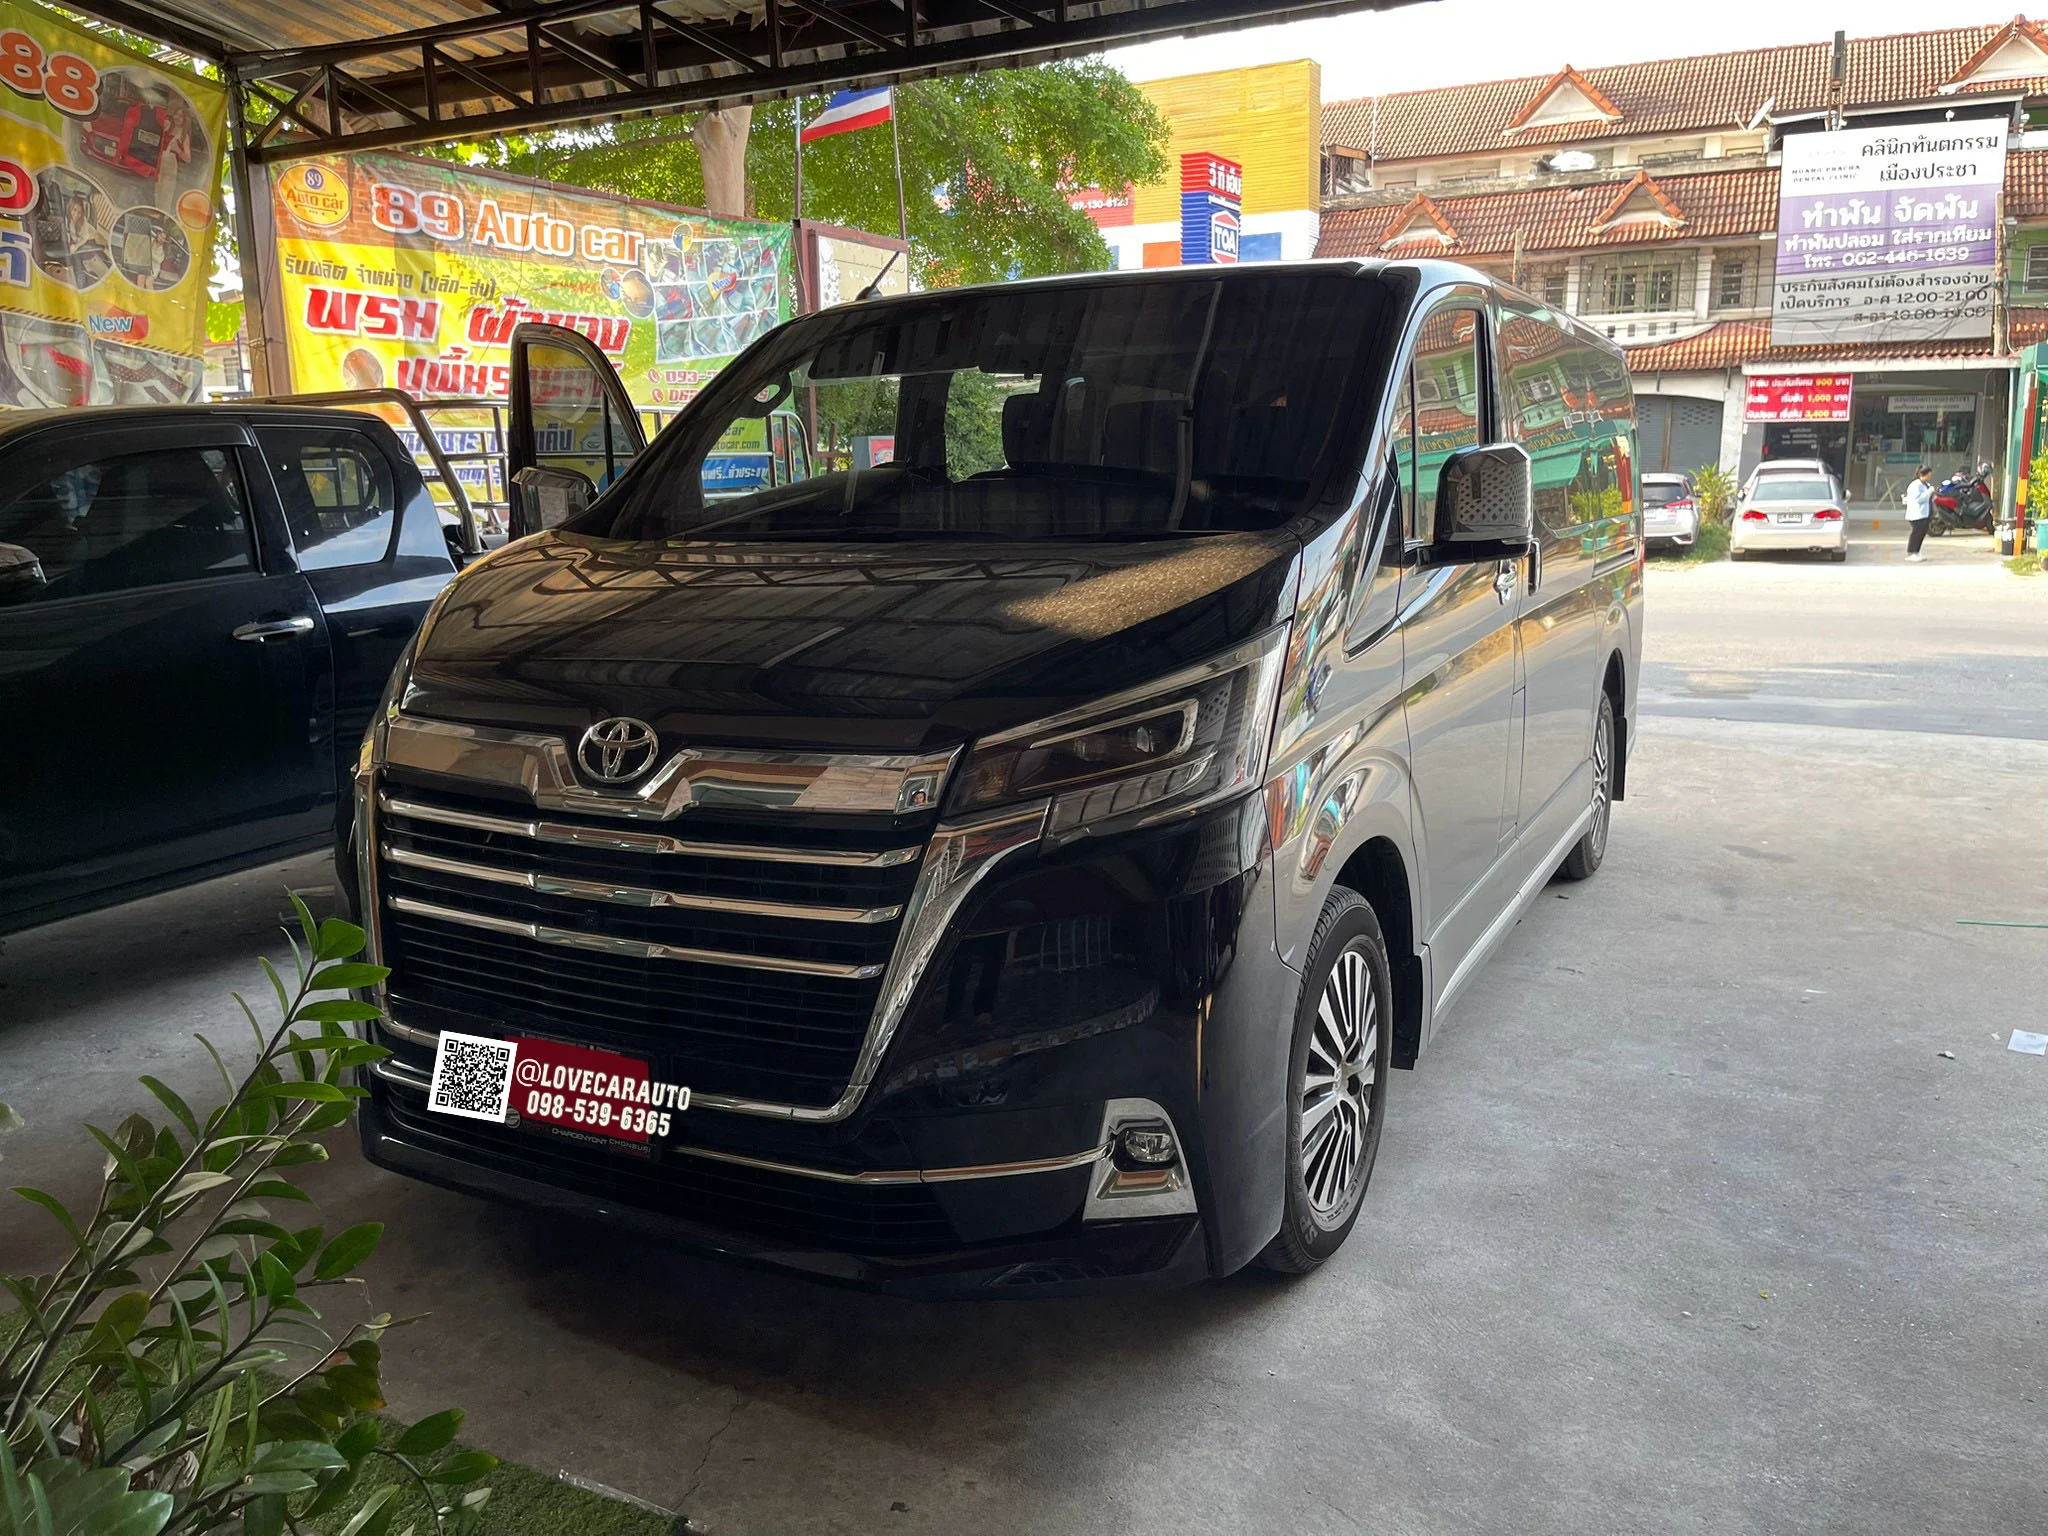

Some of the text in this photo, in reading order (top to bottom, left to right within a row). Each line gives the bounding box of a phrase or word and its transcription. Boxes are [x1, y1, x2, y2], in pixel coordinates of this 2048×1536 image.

[1862, 134, 1999, 158] คลินิกทันตกรรม
[306, 171, 322, 189] 89
[1880, 162, 1977, 183] เมืองประชา
[286, 188, 345, 210] Auto car
[1801, 193, 1979, 229] ทำฟัน จัดฟัน
[371, 183, 645, 265] 89 Auto car
[1215, 227, 1236, 253] TOA
[1784, 224, 1993, 253] ทำฟันปลอม ใส่รากเทียม
[286, 254, 348, 281] รับผลิต
[356, 264, 413, 289] จำหน่าย
[712, 275, 732, 291] New
[305, 287, 439, 342] พรม
[1780, 295, 1850, 310] เปิดบริการ
[89, 313, 133, 333] New
